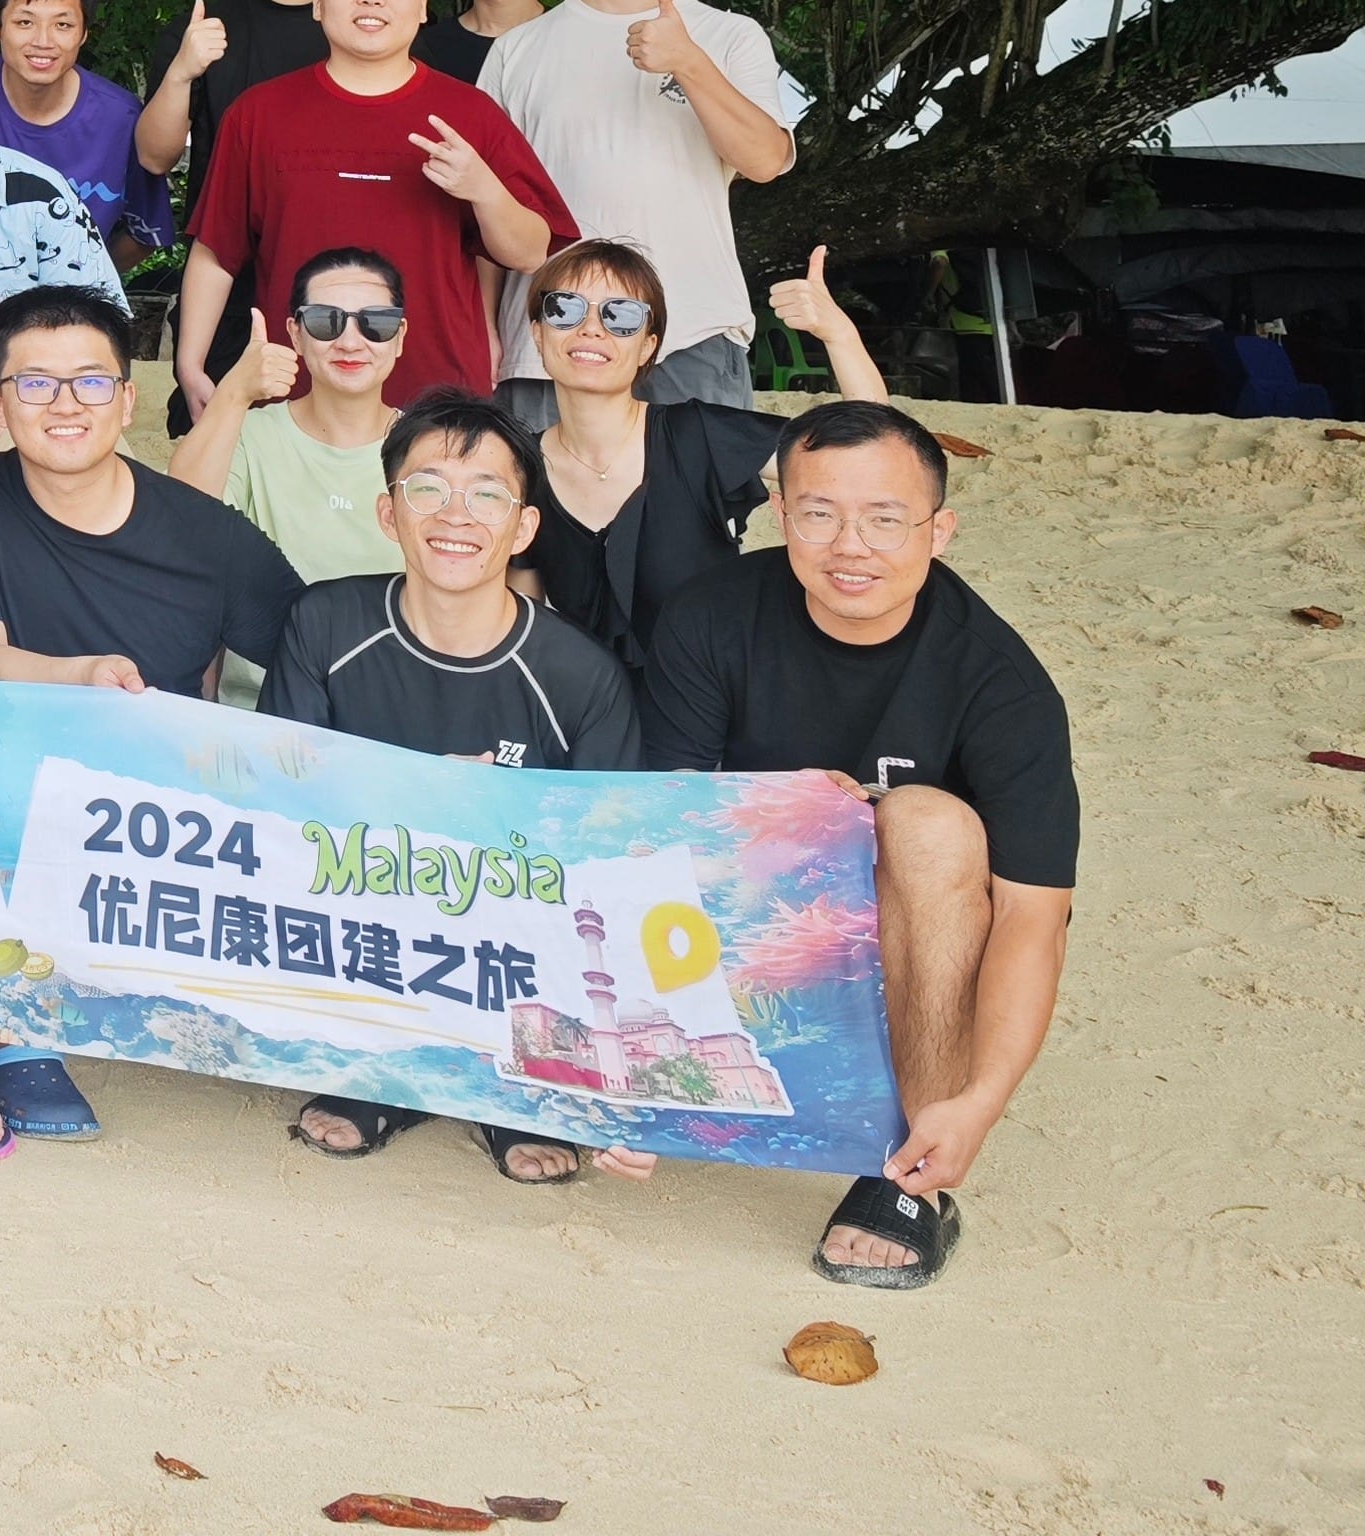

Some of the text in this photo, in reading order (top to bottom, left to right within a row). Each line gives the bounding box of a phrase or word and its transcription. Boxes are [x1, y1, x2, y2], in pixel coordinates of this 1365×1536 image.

[83, 797, 568, 916] 2024 Malaysia
[77, 874, 540, 1012] 优尼康团建之旅
